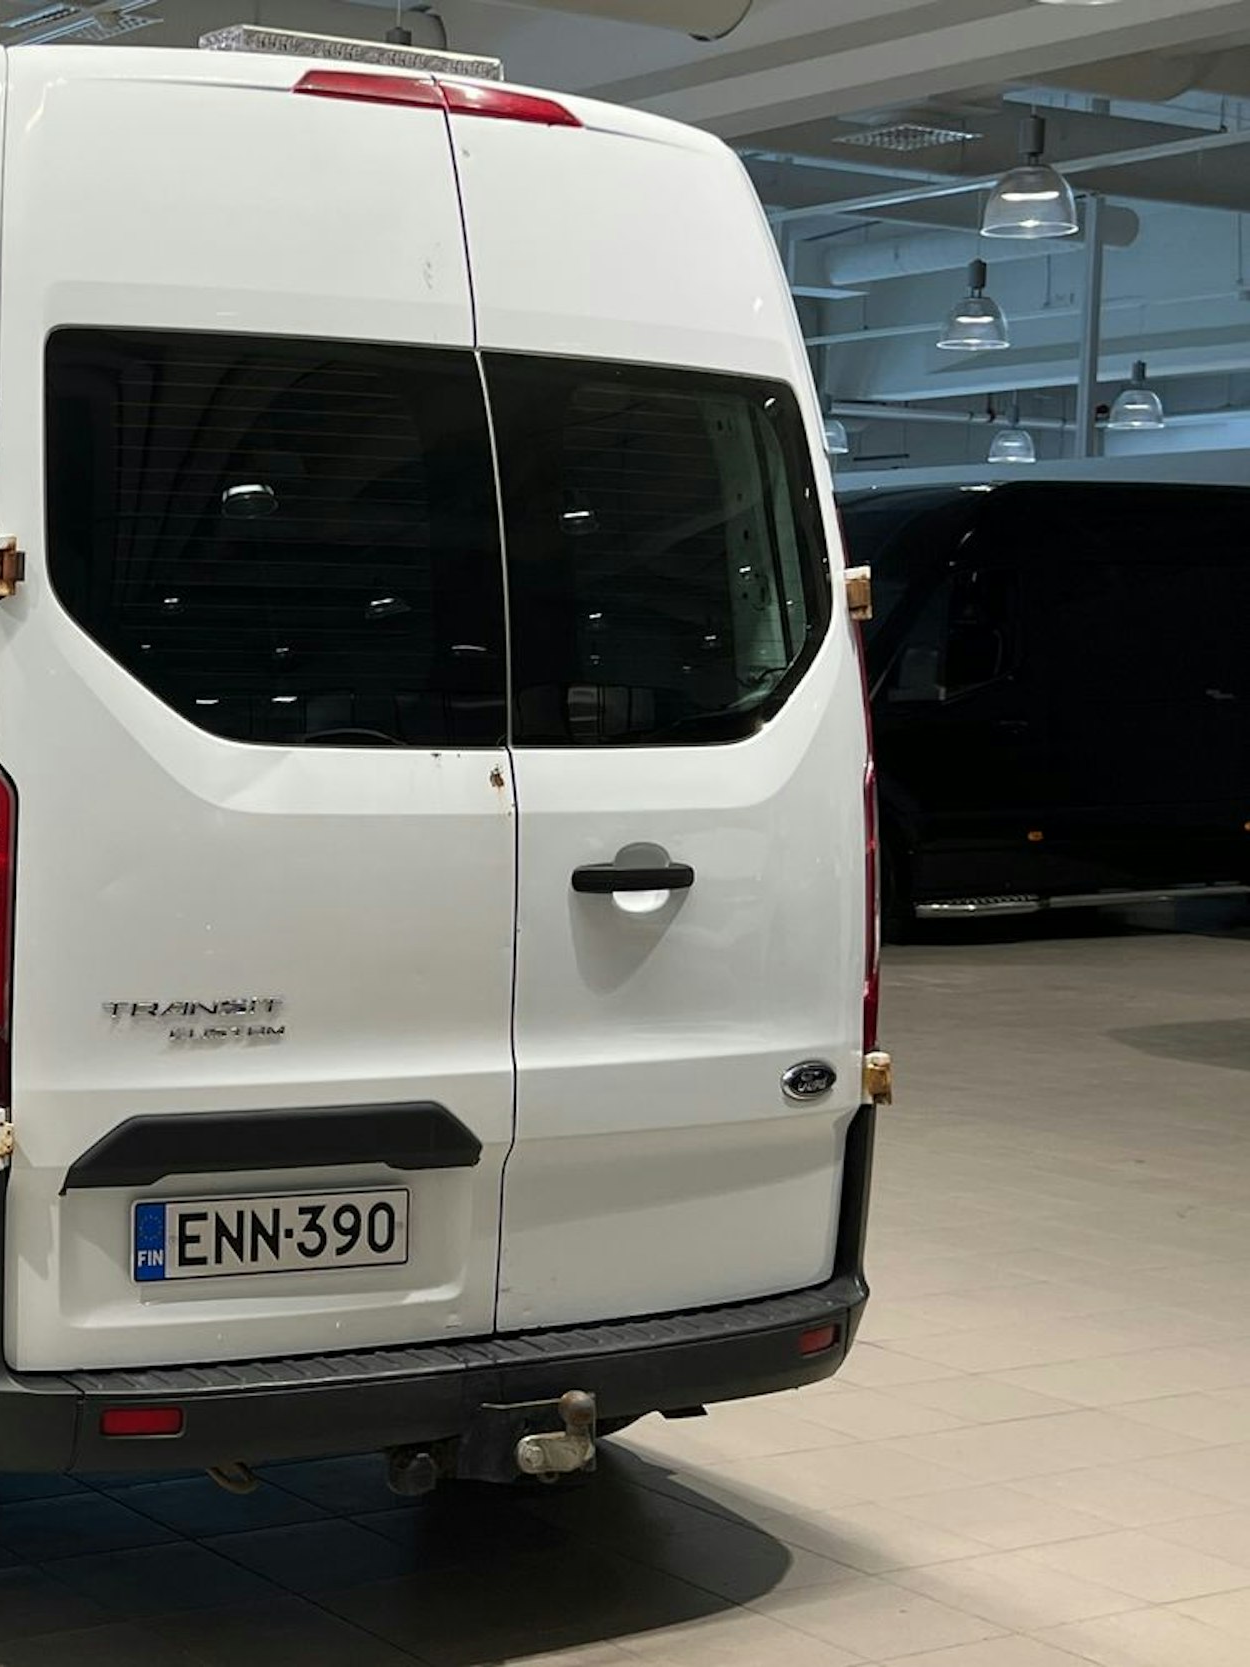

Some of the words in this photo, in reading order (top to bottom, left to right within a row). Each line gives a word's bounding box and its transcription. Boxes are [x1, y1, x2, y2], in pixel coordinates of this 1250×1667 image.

[103, 998, 282, 1017] TRANSIT
[178, 1202, 395, 1266] ENN-390
[137, 1250, 164, 1267] FIN
